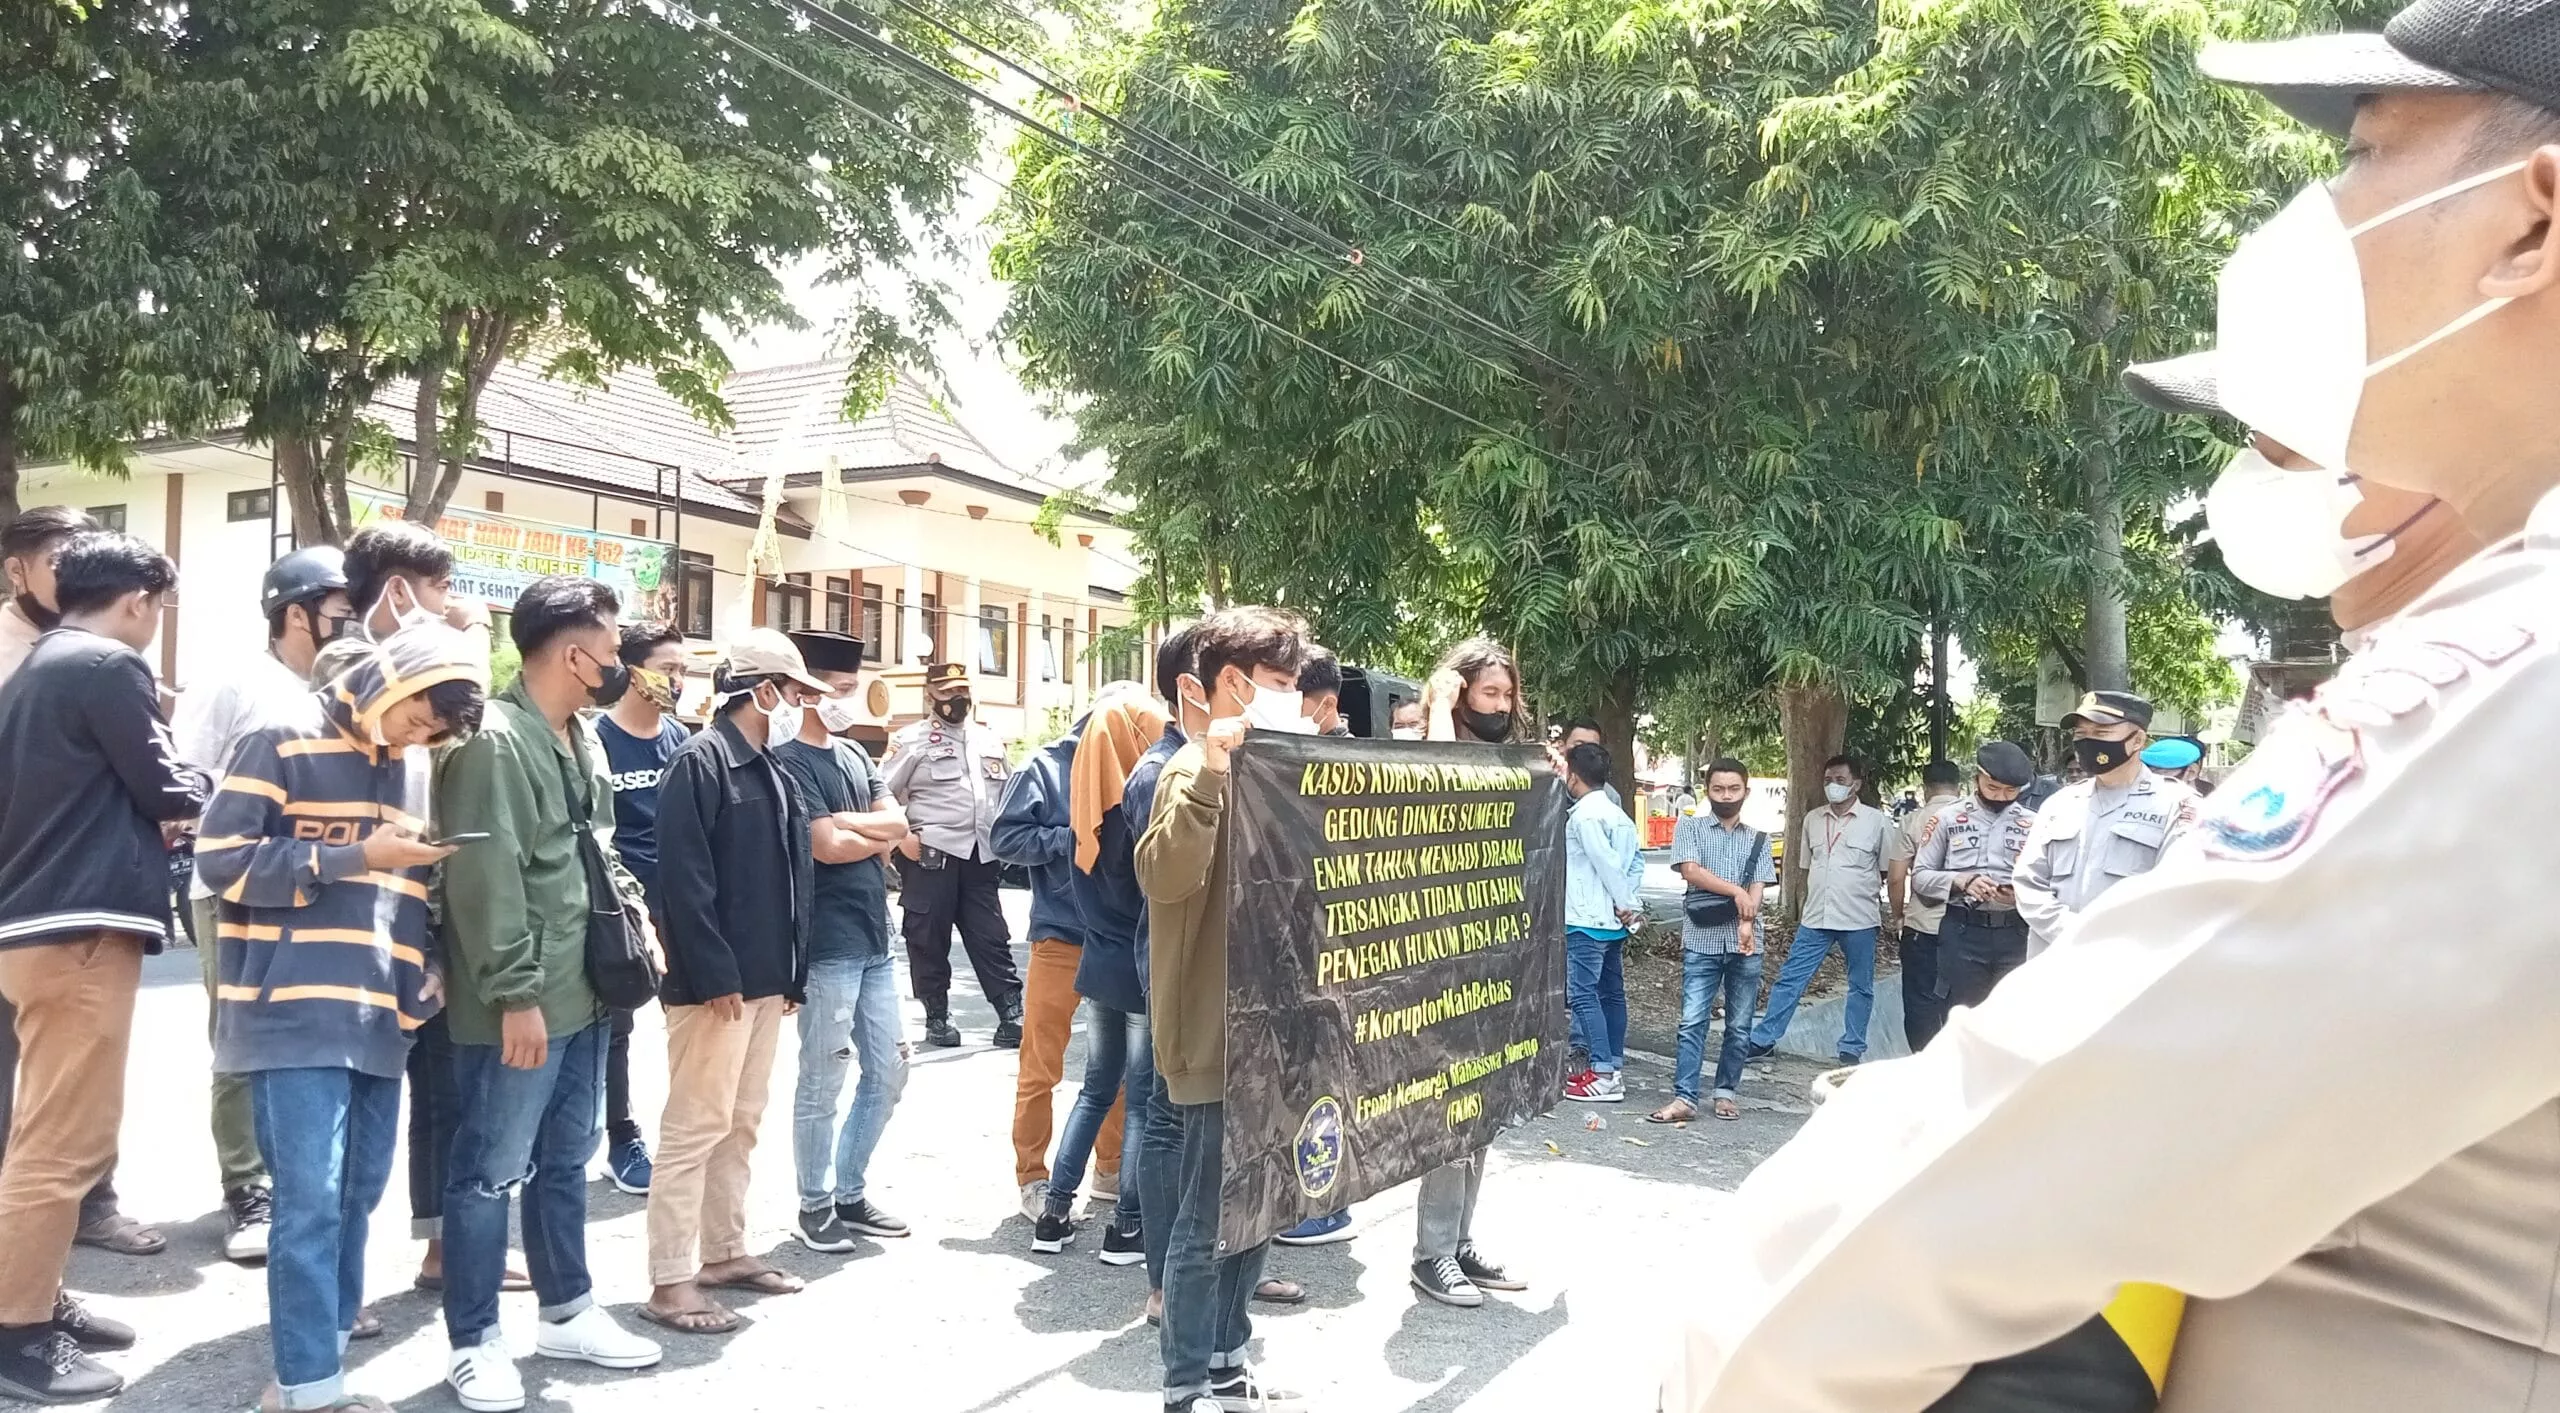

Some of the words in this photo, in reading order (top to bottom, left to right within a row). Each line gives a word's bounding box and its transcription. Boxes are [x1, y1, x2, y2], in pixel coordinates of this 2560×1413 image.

[381, 504, 469, 540] SEMAT
[524, 529, 563, 555] JADI
[452, 544, 513, 570] UPATEN
[480, 581, 520, 600] SEHAT
[1300, 762, 1367, 796] KASUS
[1369, 762, 1440, 794] KORUPSI
[1324, 806, 1398, 842] GEDUNG
[1402, 803, 1458, 837] DINKES
[1458, 801, 1515, 832] SUMENEP
[1948, 824, 1979, 836] RIBAL
[2005, 826, 2030, 836] POL
[2123, 811, 2163, 824] POLRI
[1313, 853, 1360, 891] ENAM
[1364, 848, 1417, 884] TAHUN
[1420, 842, 1478, 875] MENJADI
[1482, 838, 1525, 867] DRAMA
[1325, 893, 1421, 938] TERSANGKA
[1421, 884, 1466, 917] TIDAK
[1466, 876, 1525, 910] DITAHAN
[1317, 937, 1402, 987] PENEGAK
[1404, 927, 1460, 966] HUKUM
[1463, 919, 1492, 952] BISA
[1493, 918, 1520, 943] APA
[1521, 911, 1531, 940] ?
[1354, 977, 1513, 1044] #KoruptorMahBebas
[1355, 1090, 1393, 1123] Front
[1449, 1050, 1503, 1088] Mahasiswa
[1446, 1092, 1483, 1133] (FKMS)
